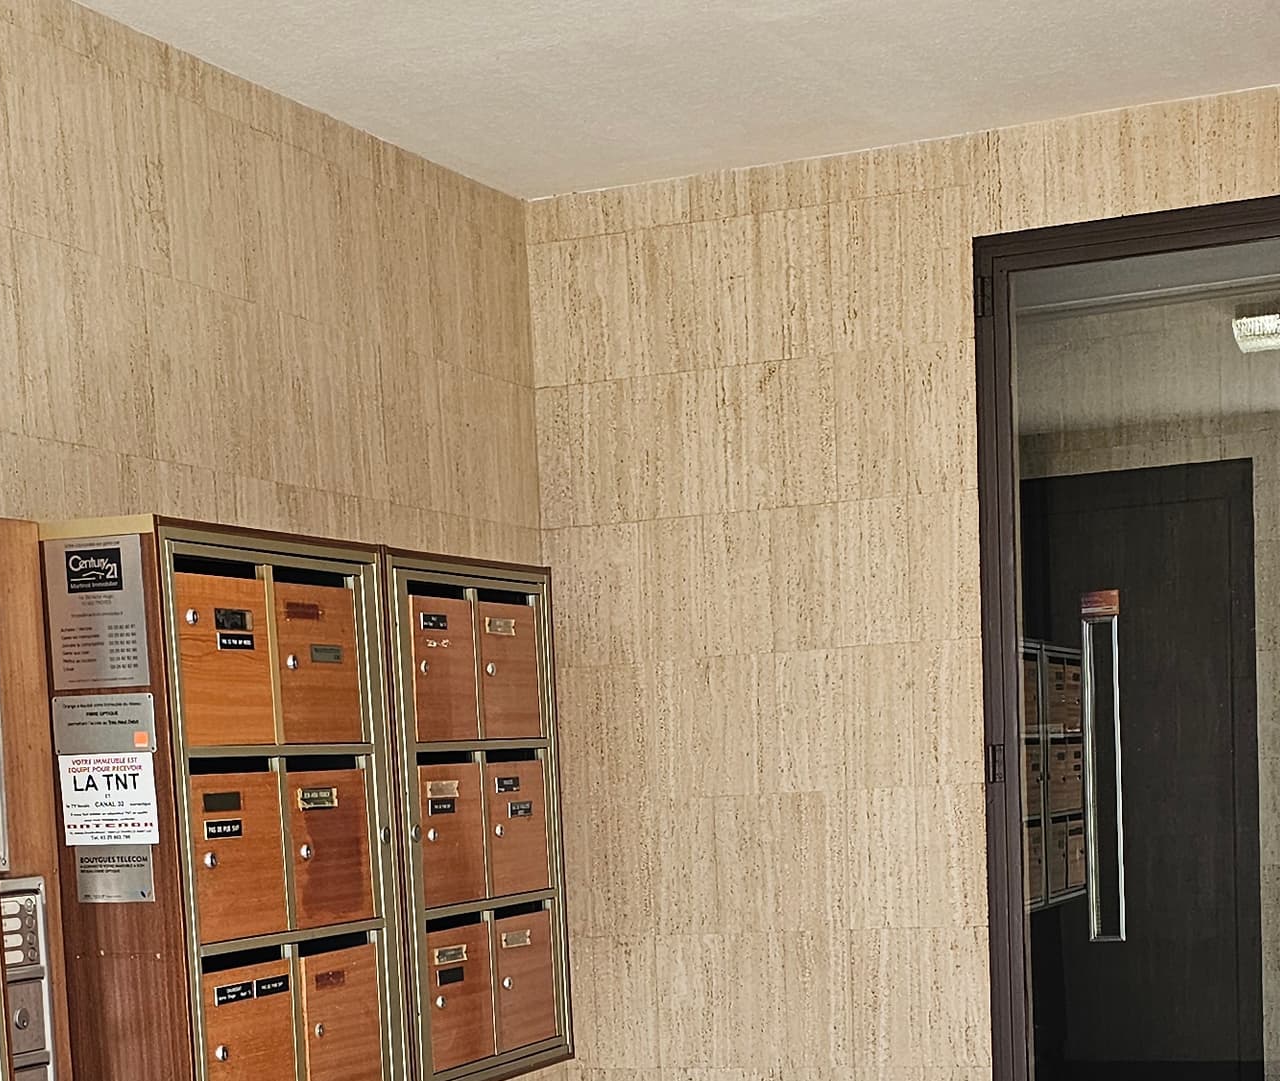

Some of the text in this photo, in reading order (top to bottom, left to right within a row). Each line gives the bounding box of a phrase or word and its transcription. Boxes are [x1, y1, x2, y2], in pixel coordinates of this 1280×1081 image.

[68, 555, 118, 579] Century 21
[71, 758, 91, 766] VOTRE
[111, 764, 142, 772] RECEVOIR
[72, 772, 139, 791] LA TNT
